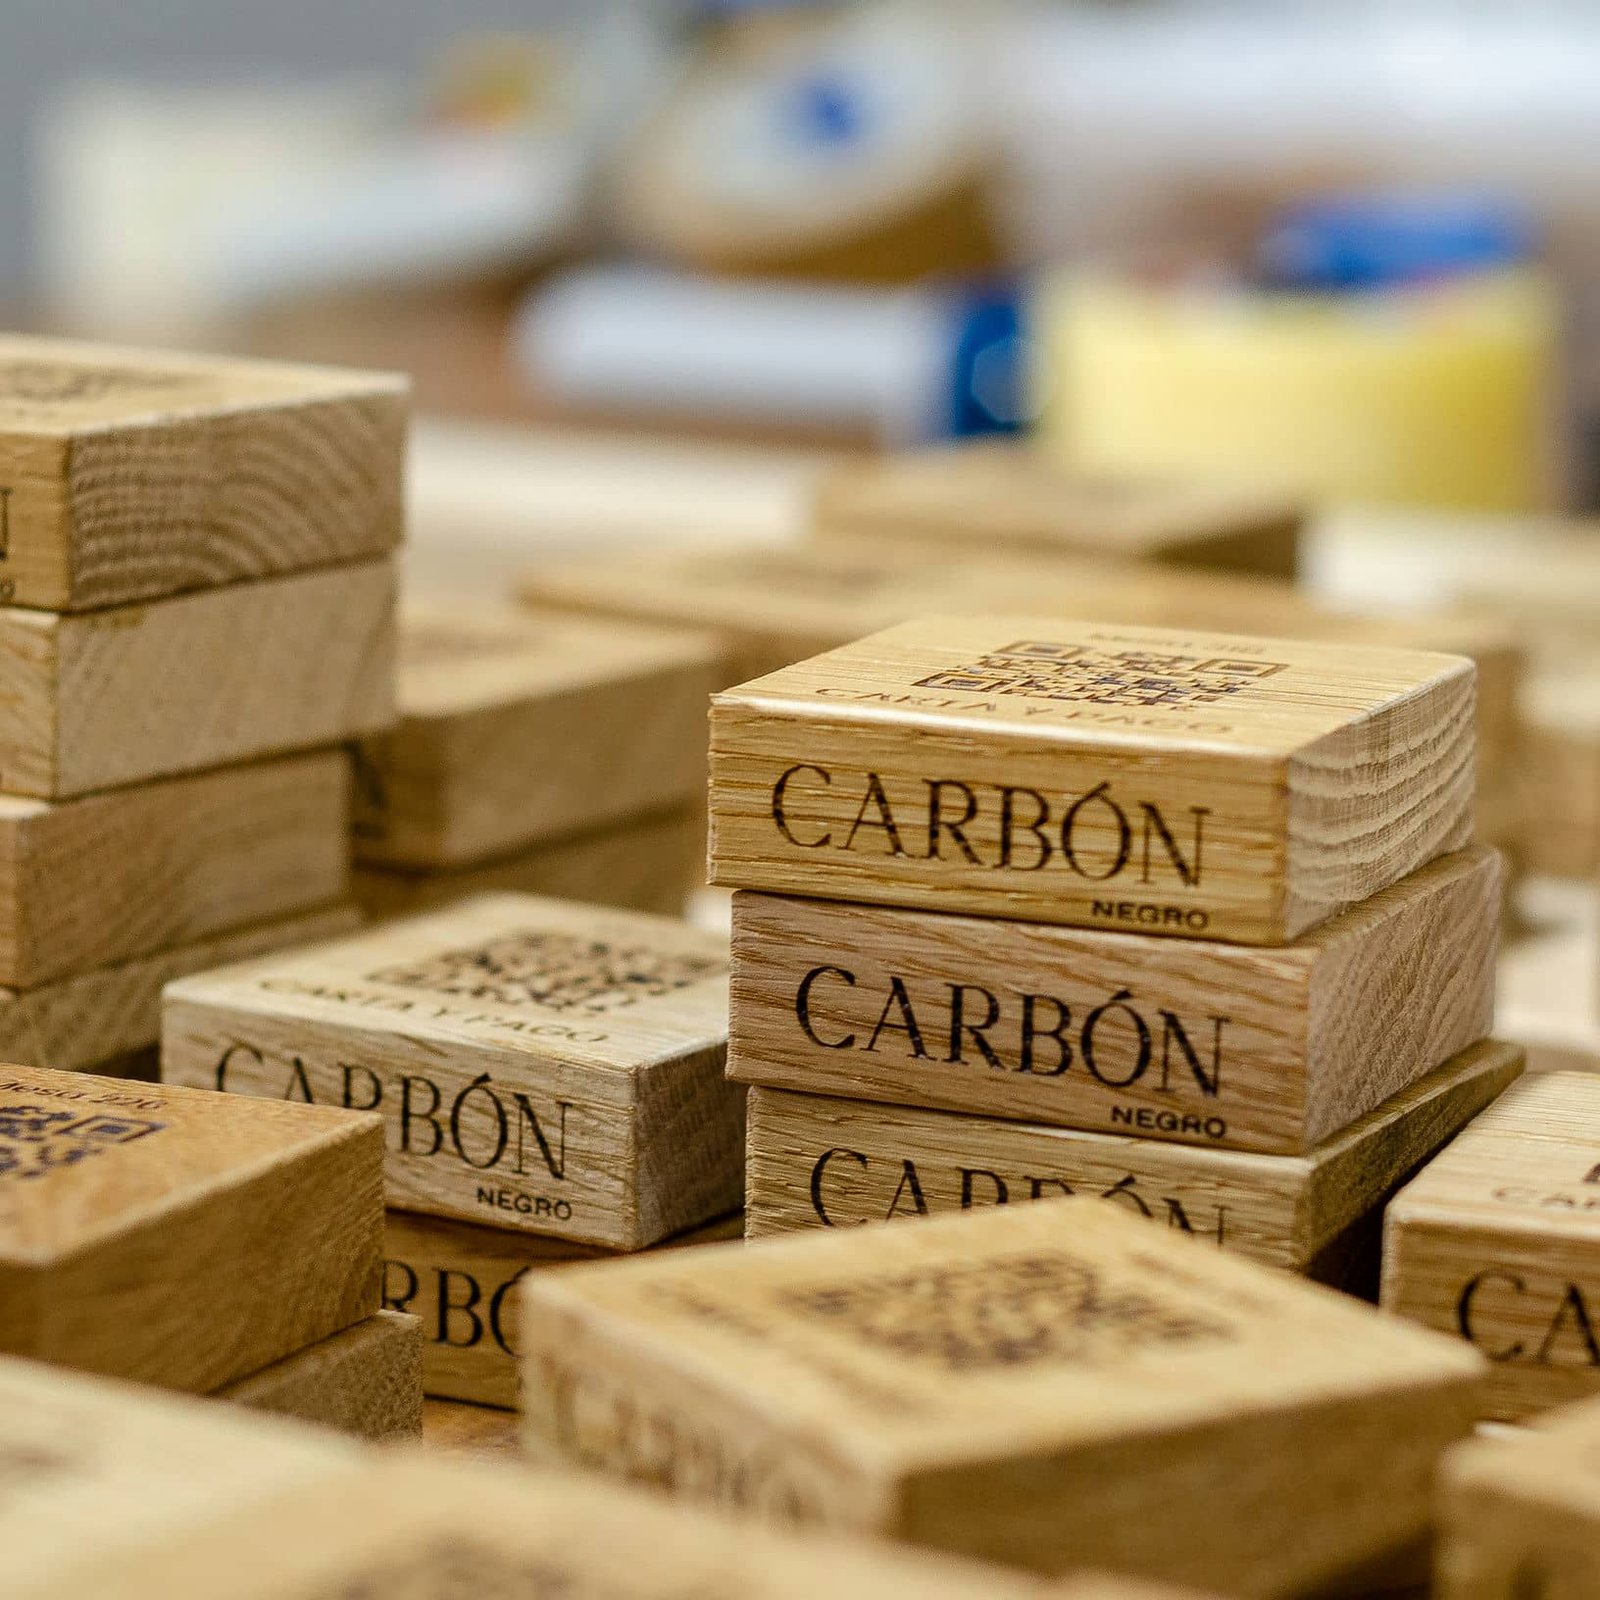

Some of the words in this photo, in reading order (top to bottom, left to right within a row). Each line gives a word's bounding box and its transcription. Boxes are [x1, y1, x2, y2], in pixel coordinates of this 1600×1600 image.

[815, 687, 997, 712] CARTA
[1024, 705, 1055, 717] Y
[1065, 710, 1235, 734] PAGO
[770, 763, 1212, 888] CARBÓN
[1090, 900, 1210, 931] NEGRO
[795, 965, 1231, 1099] CARBÓN
[1110, 1104, 1227, 1140] NEGRO
[476, 1186, 574, 1222] NEGRO
[809, 1147, 1234, 1246] CAR
